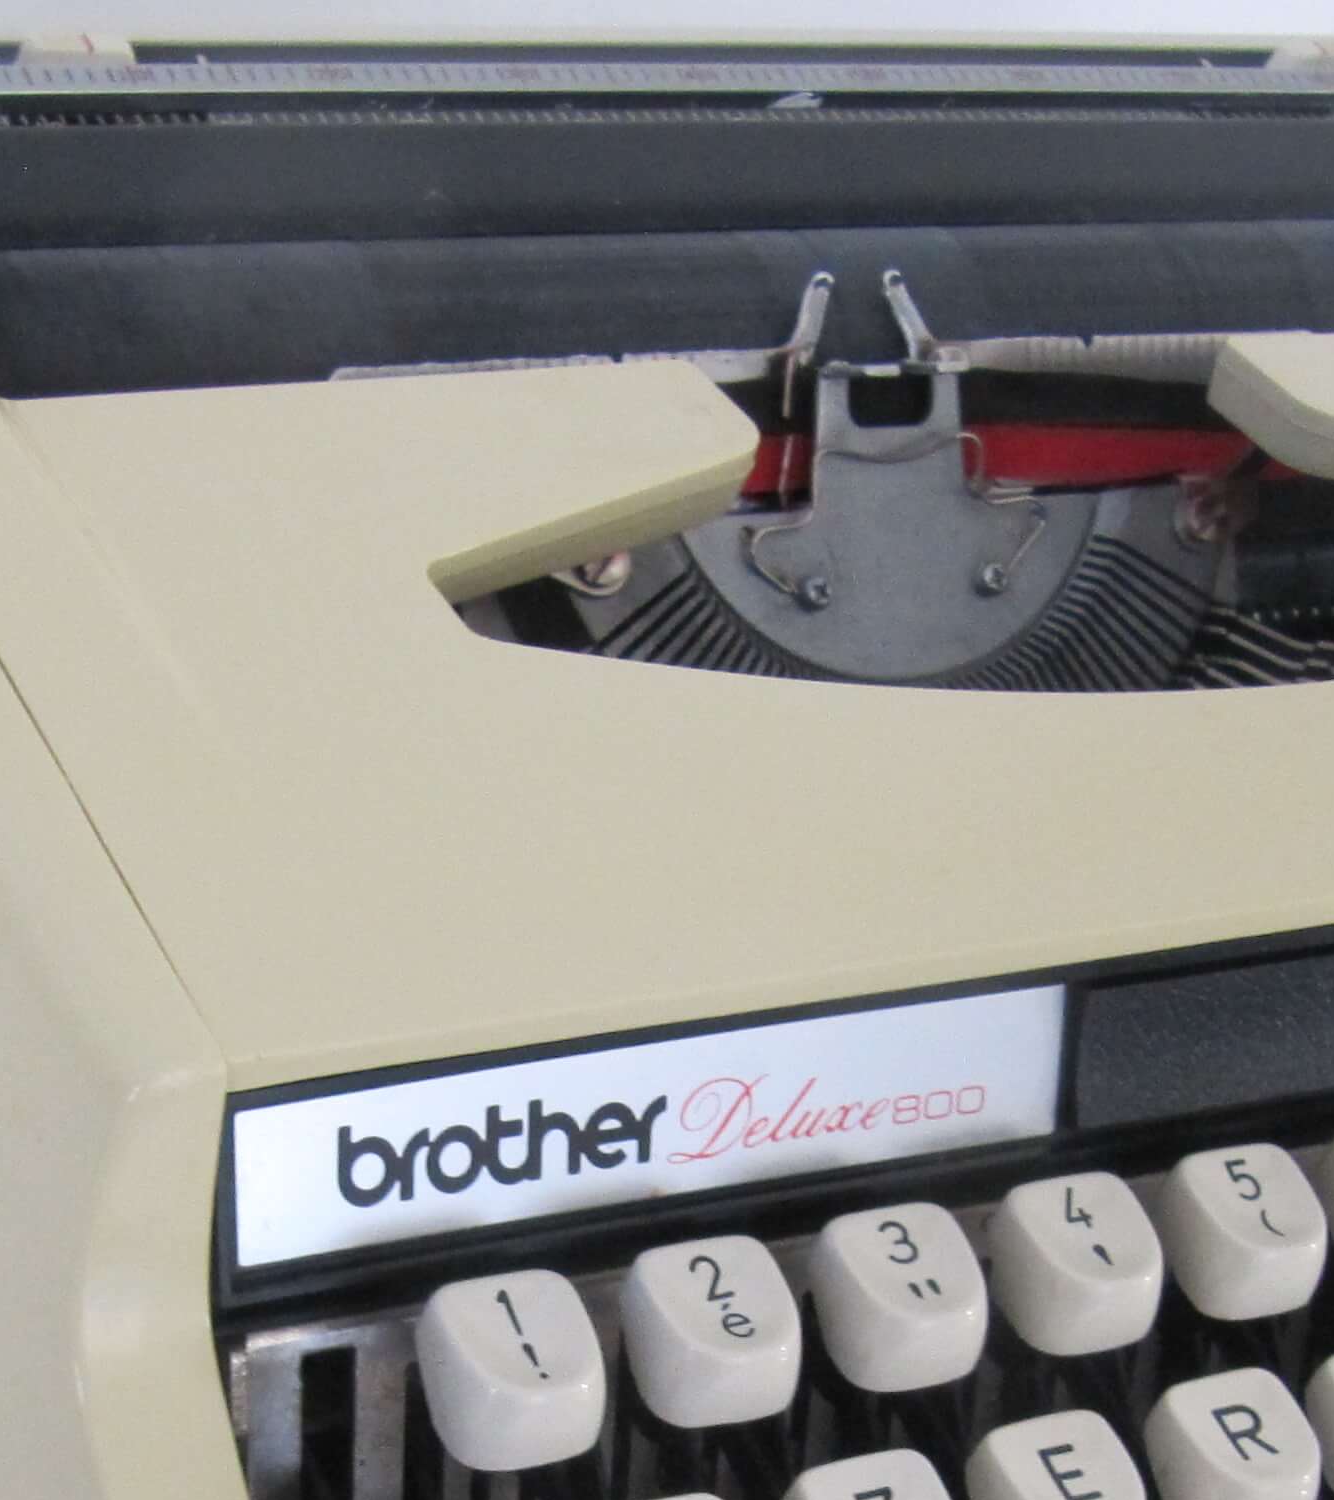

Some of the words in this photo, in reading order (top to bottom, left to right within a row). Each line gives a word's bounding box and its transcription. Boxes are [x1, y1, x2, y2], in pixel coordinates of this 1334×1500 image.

[336, 1094, 667, 1208] brother
[668, 1074, 892, 1164] Deluxe
[891, 1085, 985, 1125] 800
[496, 1289, 523, 1336] 1
[688, 1255, 735, 1302] 2
[878, 1220, 919, 1265] 3
[1065, 1187, 1093, 1228] 4
[1224, 1158, 1262, 1201] 5
[522, 1342, 549, 1380] !
[1211, 1404, 1280, 1461] R
